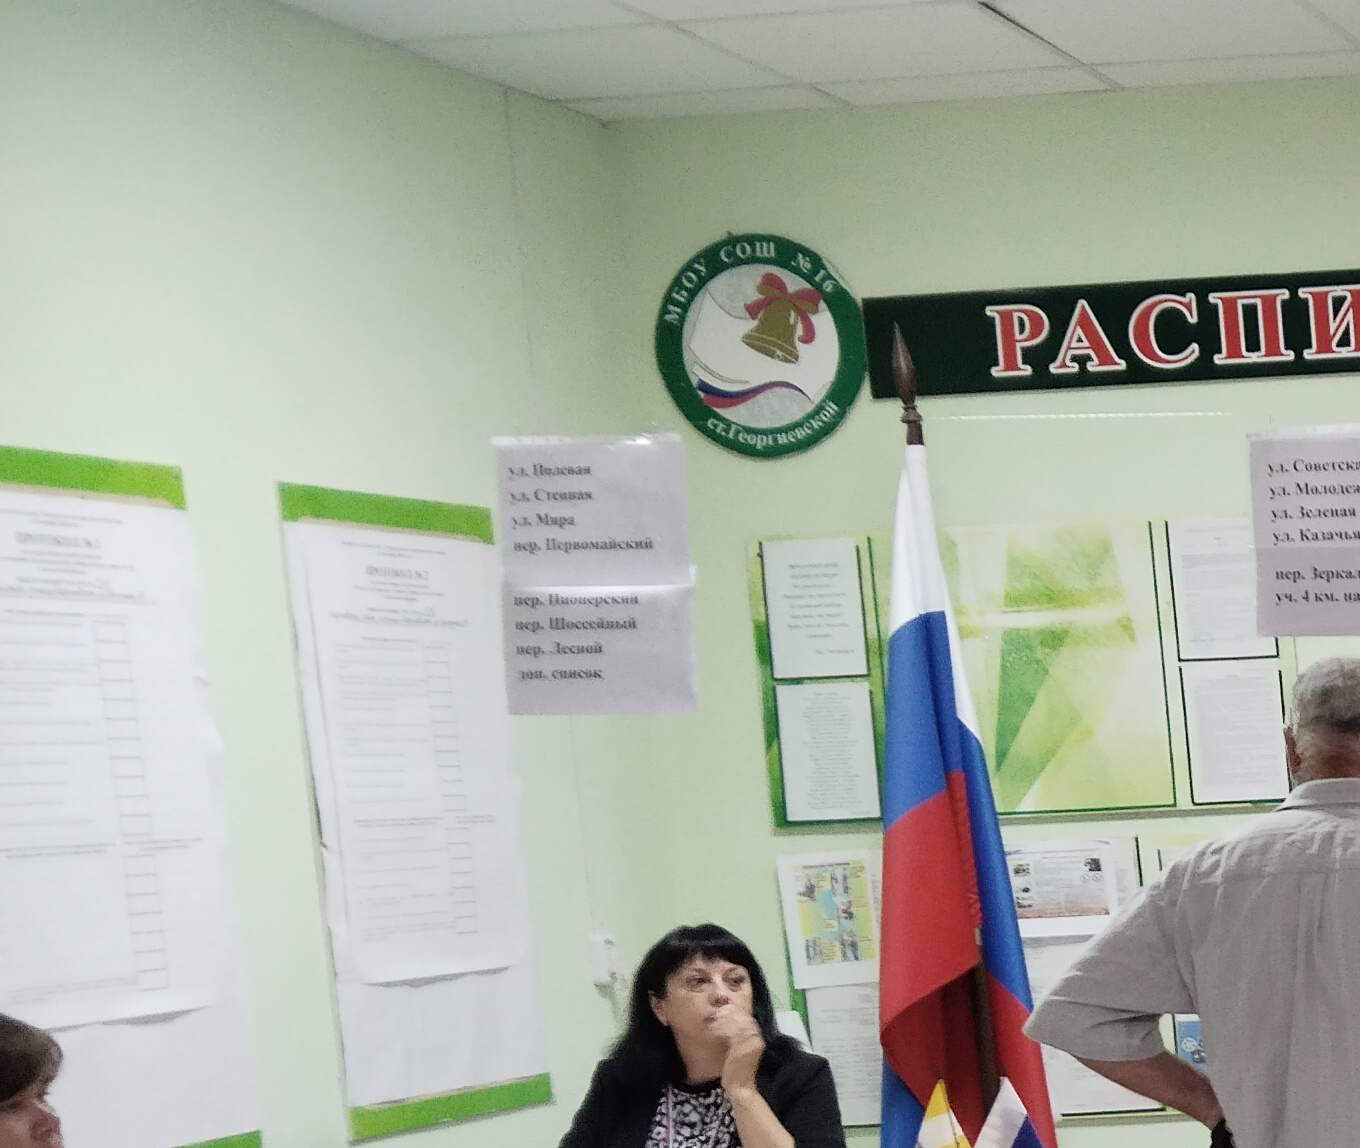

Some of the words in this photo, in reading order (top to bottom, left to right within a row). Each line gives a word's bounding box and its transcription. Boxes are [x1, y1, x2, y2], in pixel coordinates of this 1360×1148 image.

[664, 257, 707, 325] МБОУ
[719, 241, 776, 263] СОШ
[533, 463, 591, 476] Полевая
[1267, 463, 1289, 477] ул.
[1270, 486, 1290, 499] ул.
[536, 513, 575, 528] Мира
[1271, 510, 1292, 523] ул.
[1299, 506, 1356, 519] Зеленая
[1273, 532, 1295, 545] ул.
[1300, 529, 1360, 542] Казачья
[545, 537, 654, 553] Первомайский
[1275, 570, 1305, 583] пер.
[1275, 593, 1297, 605] уч.
[1302, 590, 1310, 602] 4
[1344, 592, 1360, 602] на
[549, 616, 637, 631] Шоссейный
[550, 641, 603, 655] Лесной
